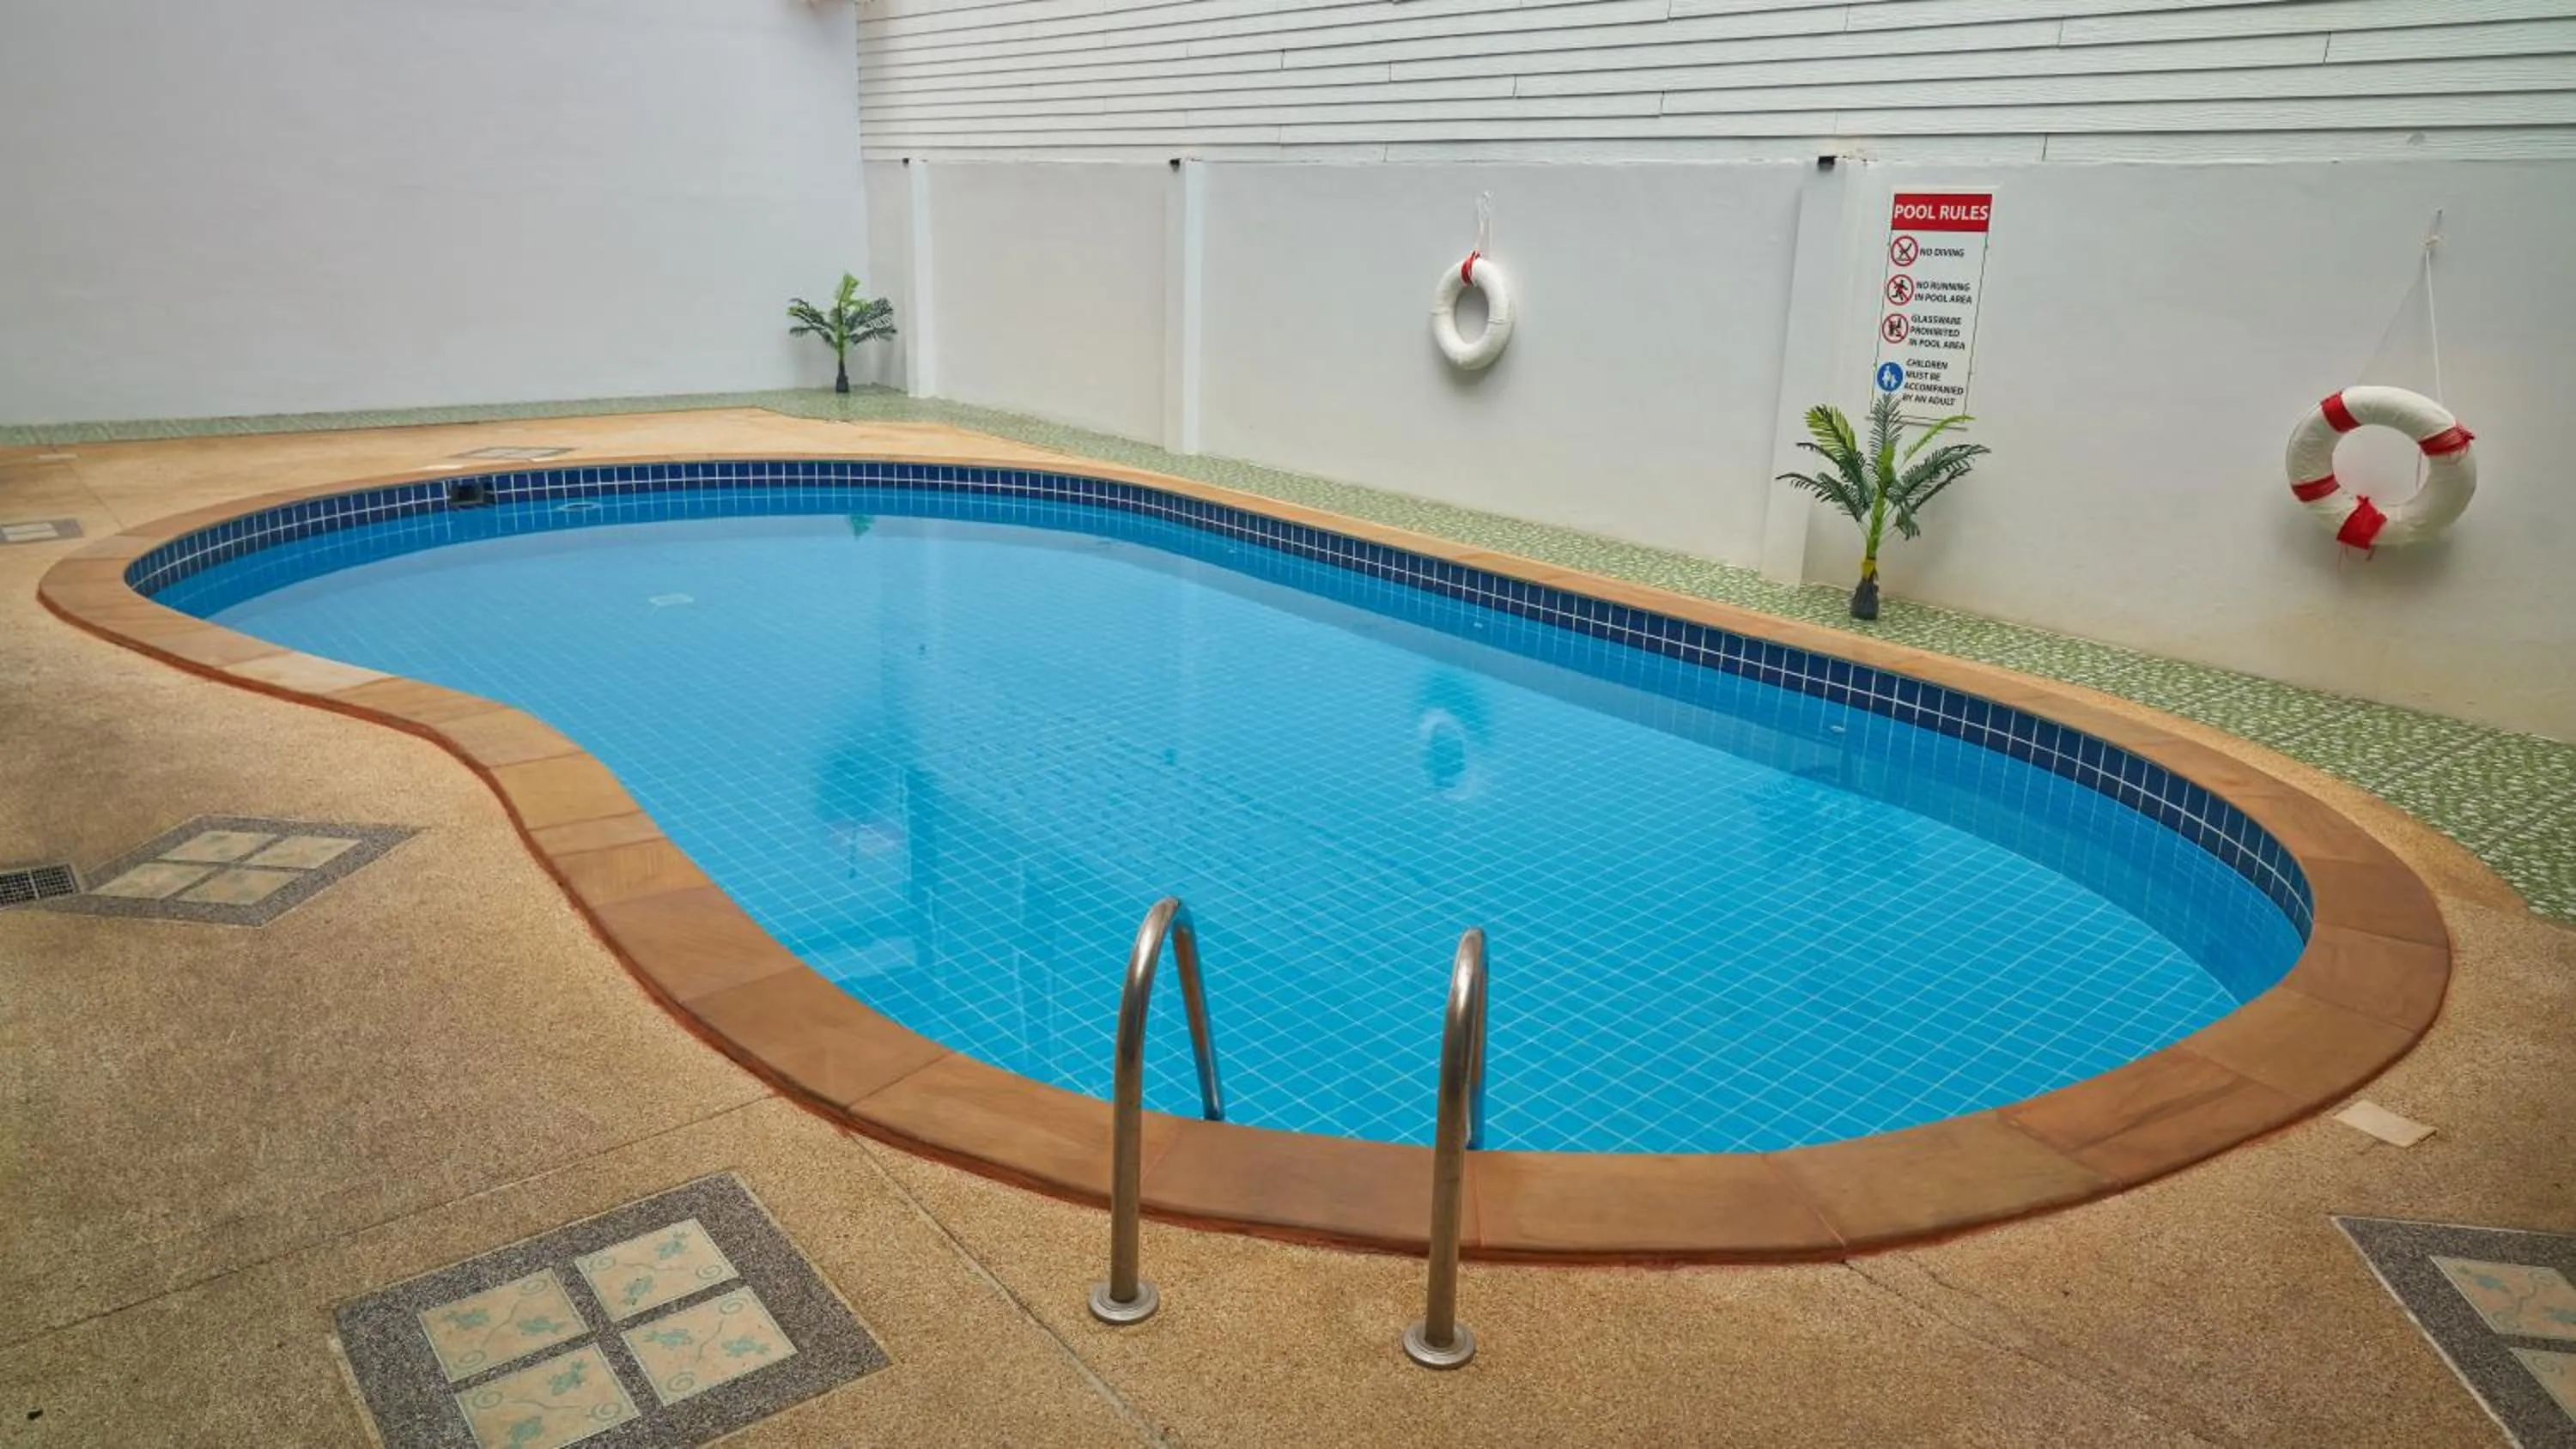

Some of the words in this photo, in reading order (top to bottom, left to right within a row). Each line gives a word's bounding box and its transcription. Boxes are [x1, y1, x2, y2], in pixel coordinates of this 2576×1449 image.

[1894, 204, 1935, 220] POOL
[1941, 205, 1989, 220] RULES
[1934, 248, 1965, 257] DIVING
[1930, 282, 1971, 292] RUNNING
[1924, 294, 1947, 302] POOL
[1949, 294, 1972, 304] AREA
[1911, 315, 1962, 324] GLASSWARE
[1910, 326, 1960, 337] PROHIBITED
[1919, 339, 1941, 349] POOL
[1943, 342, 1965, 350] AREA
[1906, 358, 1948, 369] CHILDREN
[1906, 370, 1929, 380] MUST
[1929, 373, 1941, 381] BE
[1904, 382, 1964, 395] ACCOMPANIED
[1914, 395, 1927, 403] AN
[1929, 397, 1956, 405] ADULT
